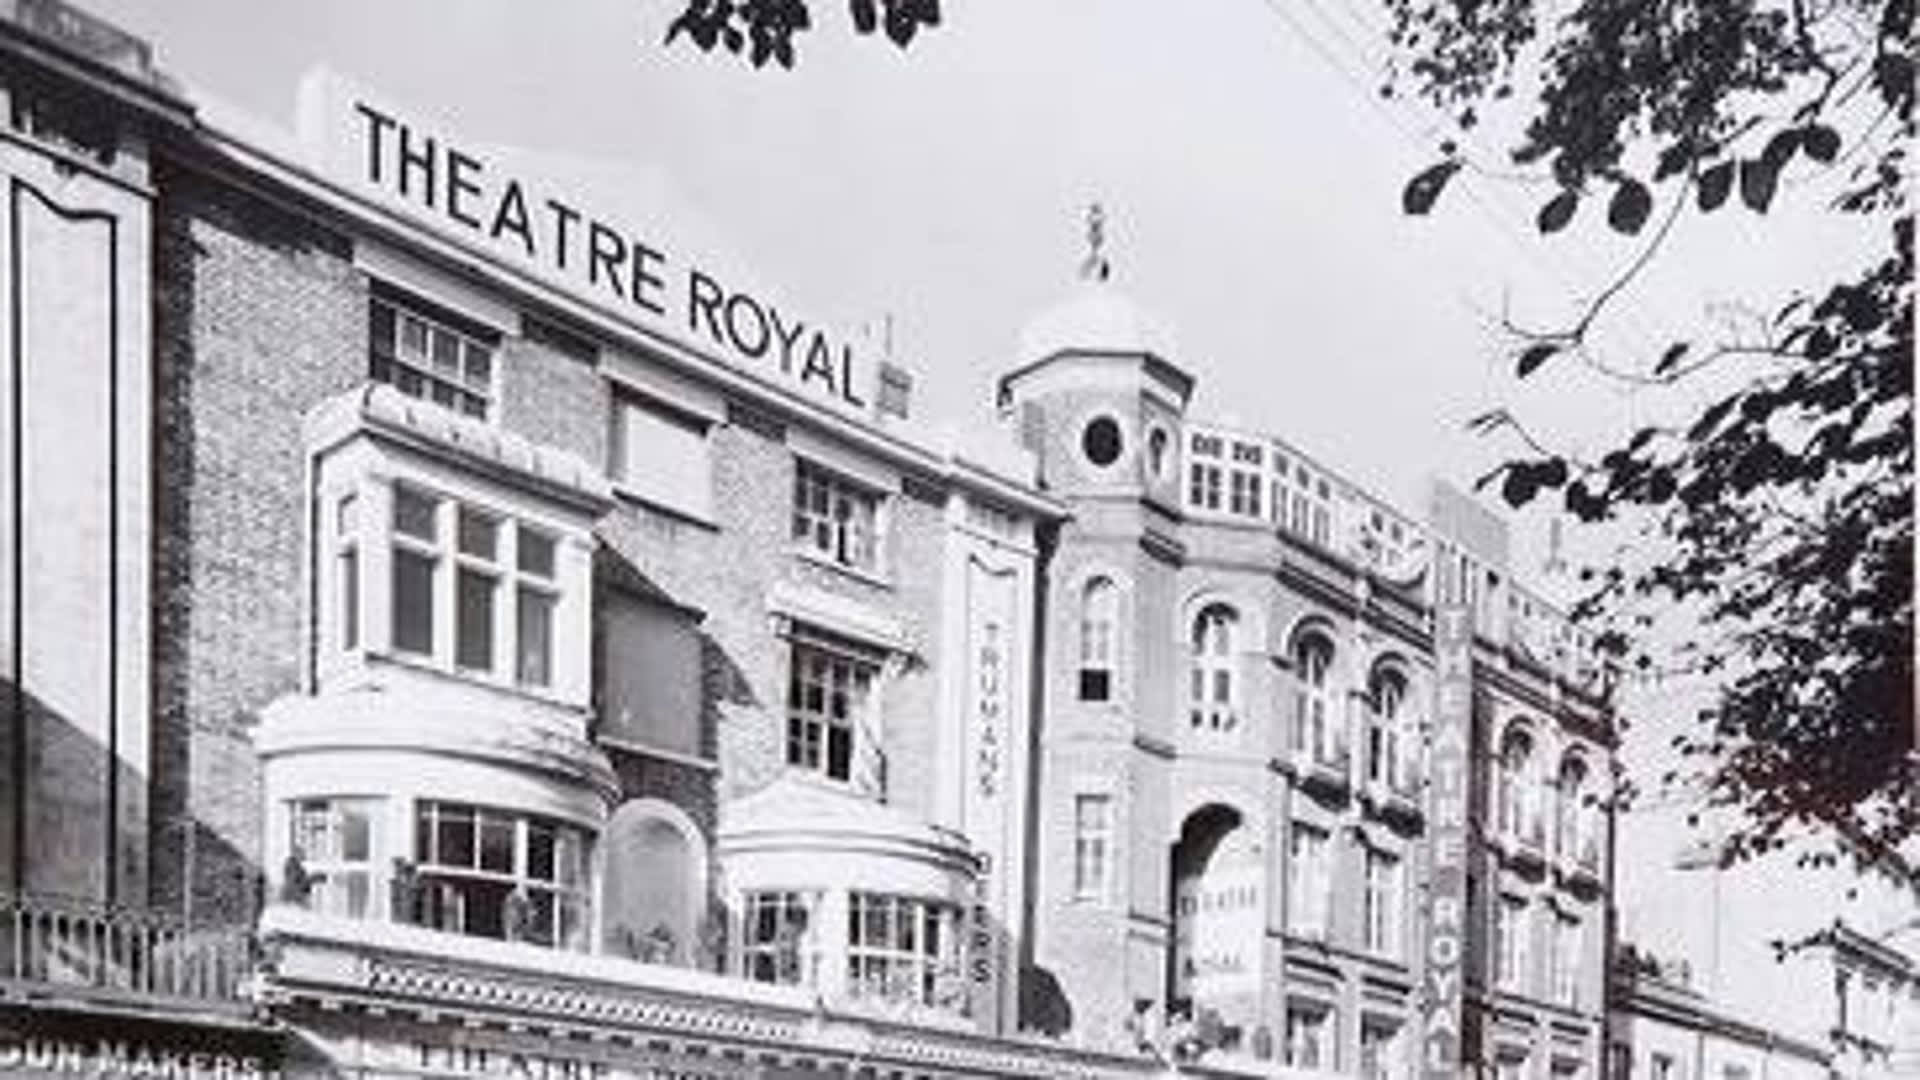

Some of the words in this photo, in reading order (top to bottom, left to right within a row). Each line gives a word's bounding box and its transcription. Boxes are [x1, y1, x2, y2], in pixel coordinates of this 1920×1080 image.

[356, 102, 666, 315] THEATRE
[689, 269, 866, 408] ROYAL
[1433, 611, 1463, 869] THEATRE
[1428, 899, 1460, 1072] ROYAL
